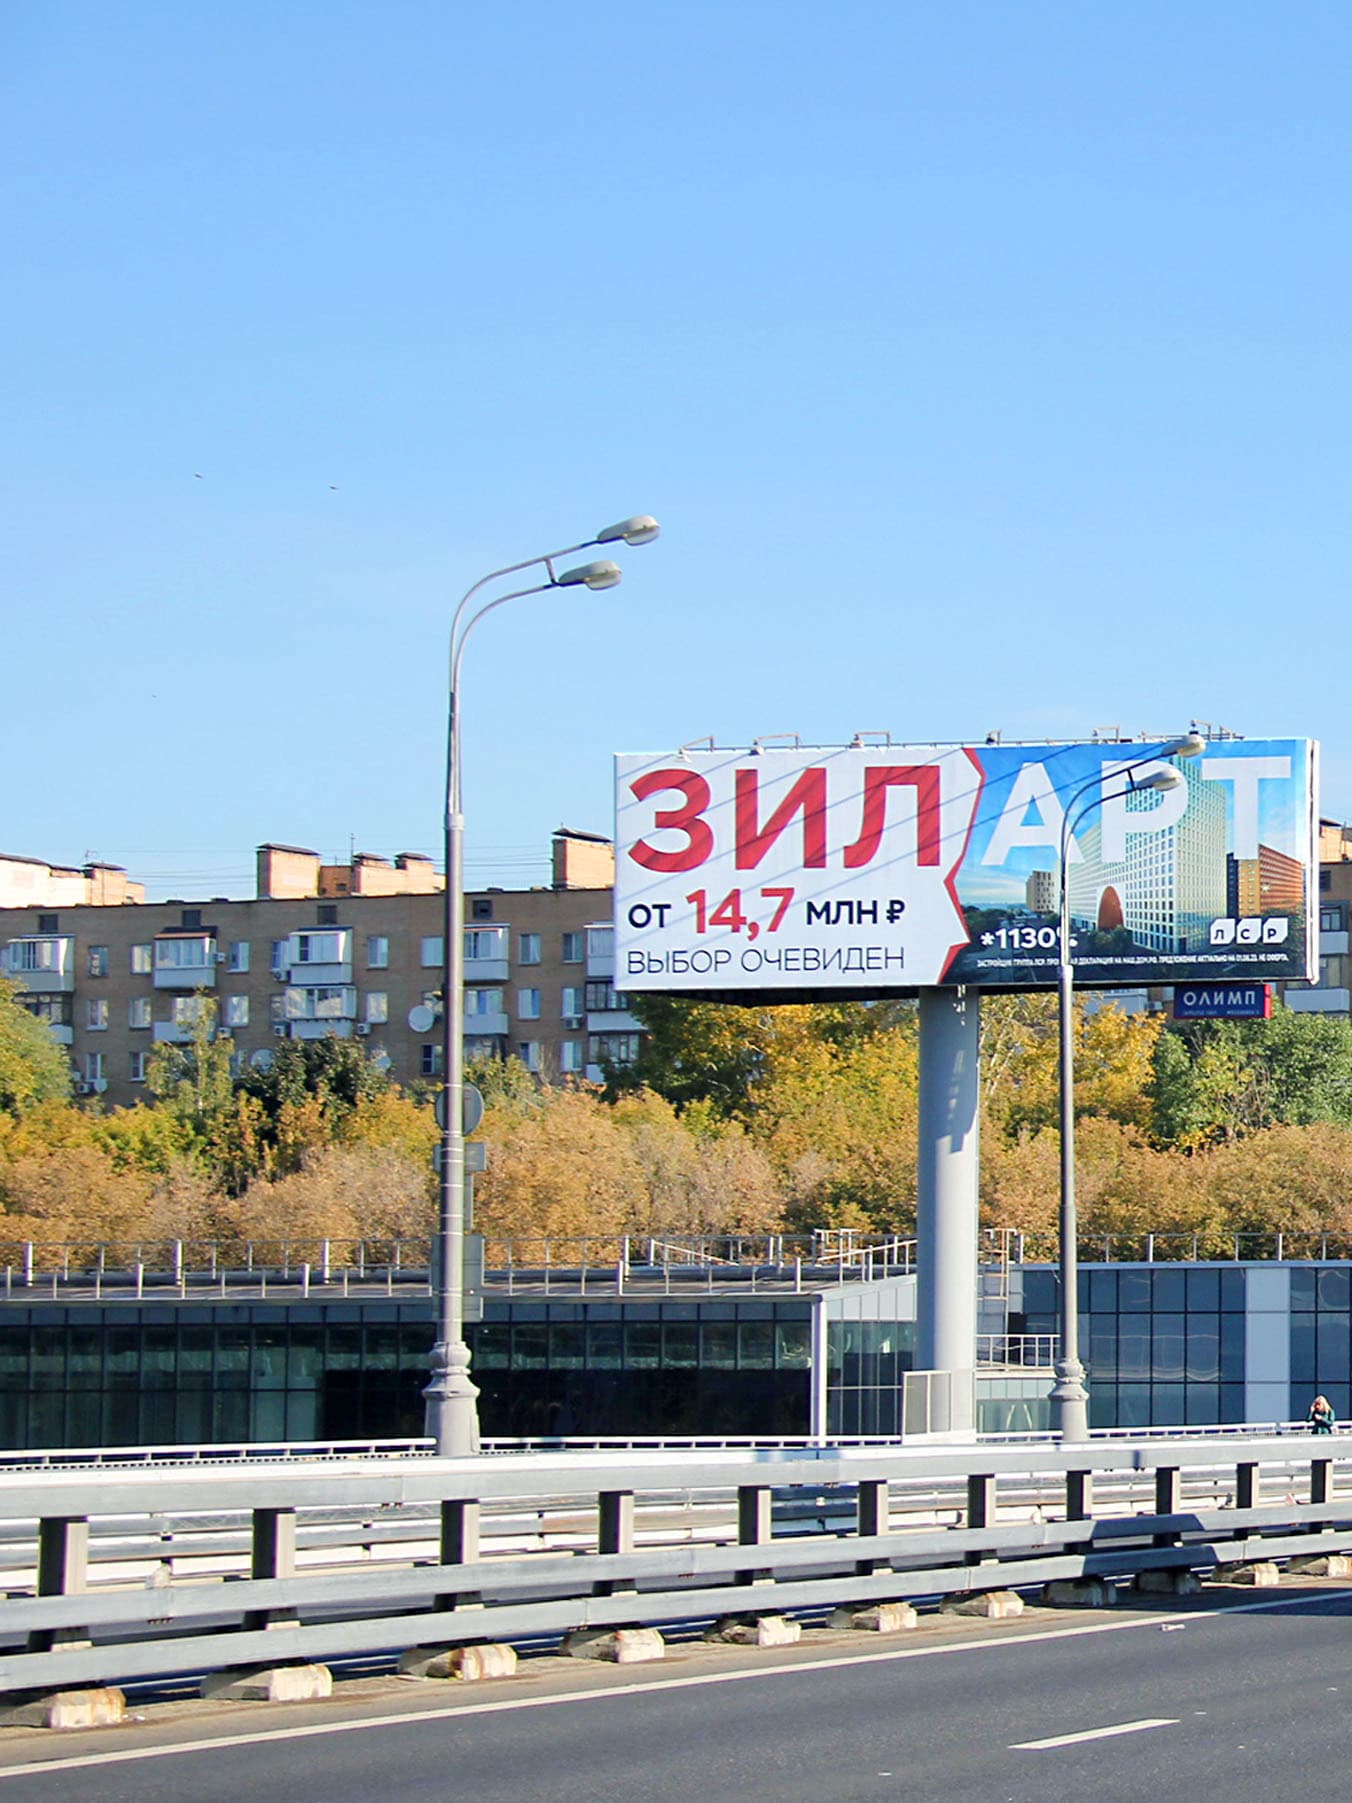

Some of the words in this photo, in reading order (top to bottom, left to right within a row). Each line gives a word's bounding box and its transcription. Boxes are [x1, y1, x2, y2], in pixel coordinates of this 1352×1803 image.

[628, 904, 672, 929] ОТ
[686, 887, 795, 941] 14,7
[806, 900, 878, 925] МЛН
[627, 950, 732, 974] ВЫБОР
[741, 947, 904, 974] ОЧЕВИДЕН
[1183, 991, 1255, 1006] ОЛИМП
